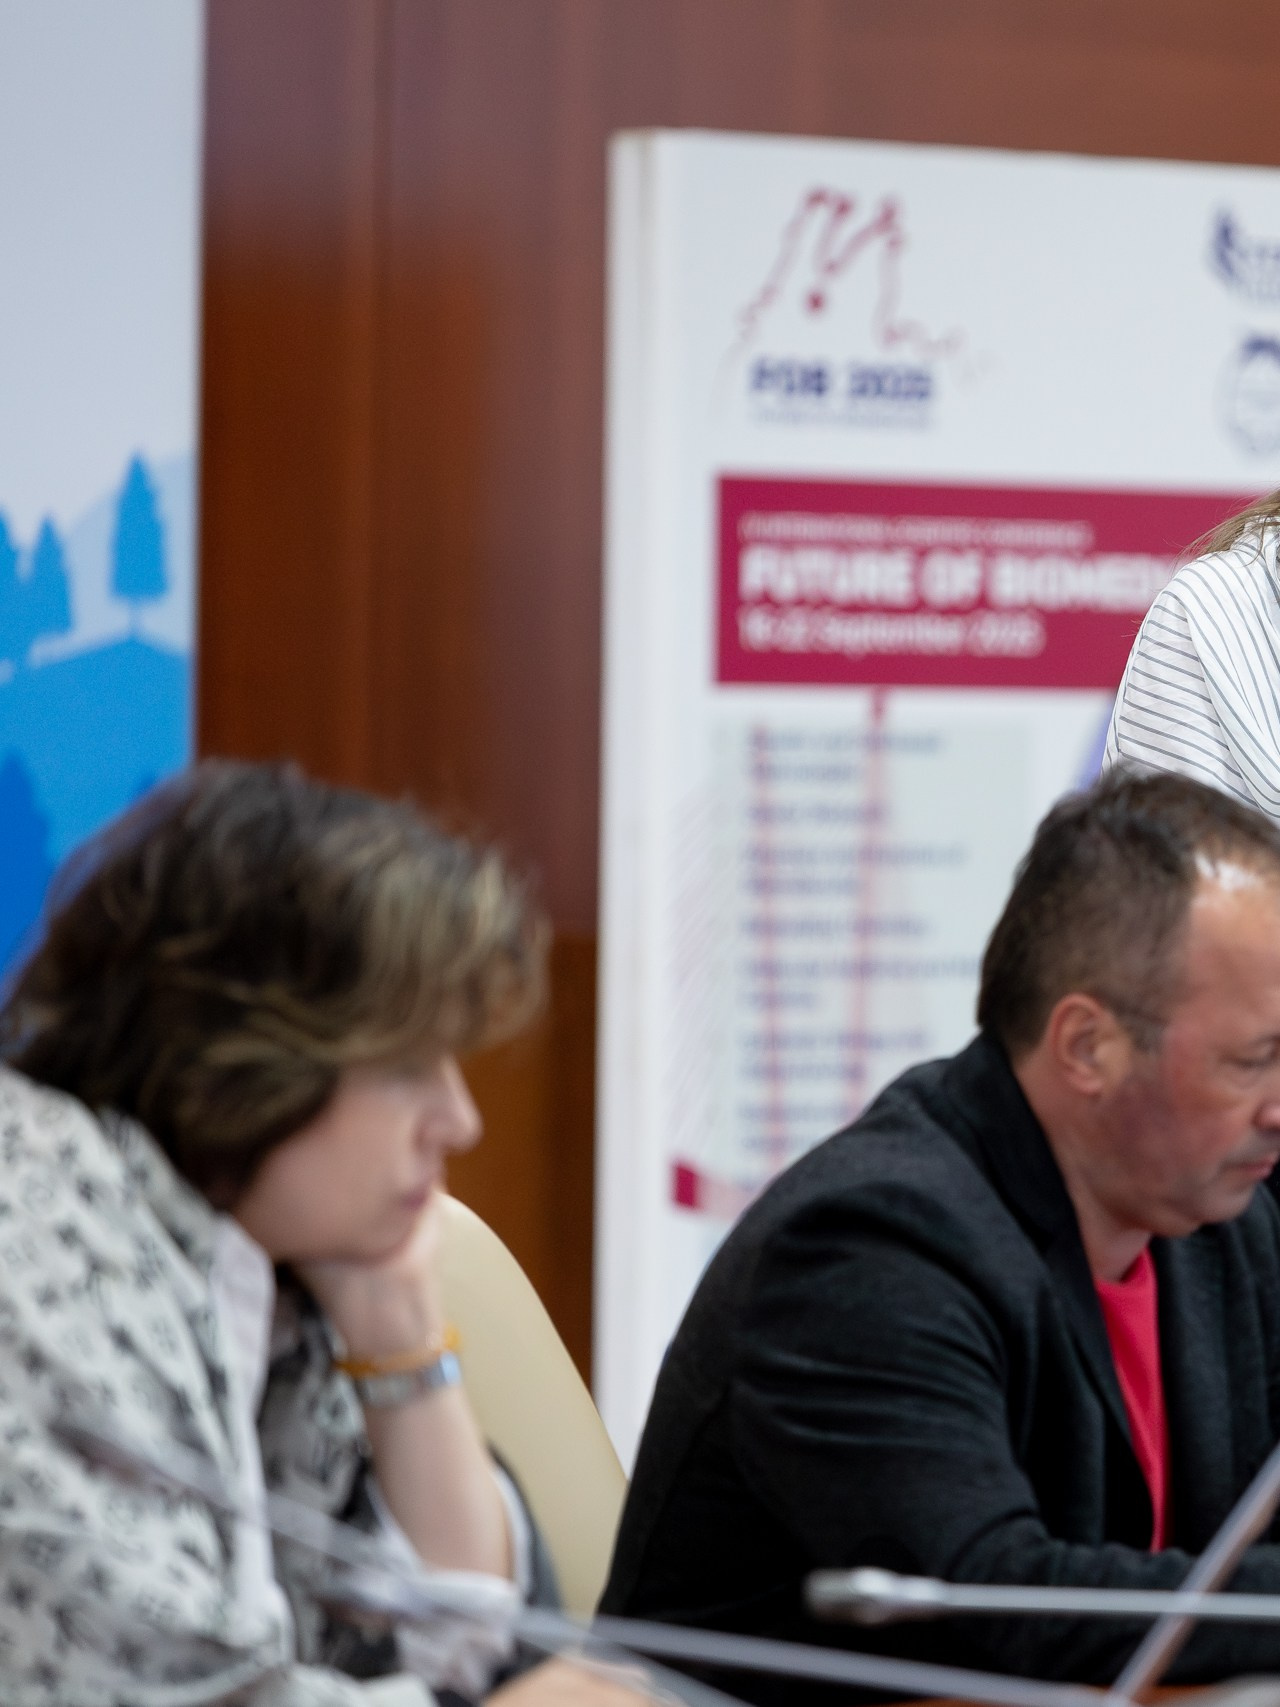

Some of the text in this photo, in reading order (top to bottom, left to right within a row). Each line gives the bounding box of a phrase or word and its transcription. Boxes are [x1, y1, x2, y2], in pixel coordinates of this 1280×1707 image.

[742, 547, 1172, 611] FUTURE OF BIOMED
[818, 612, 967, 656] September
